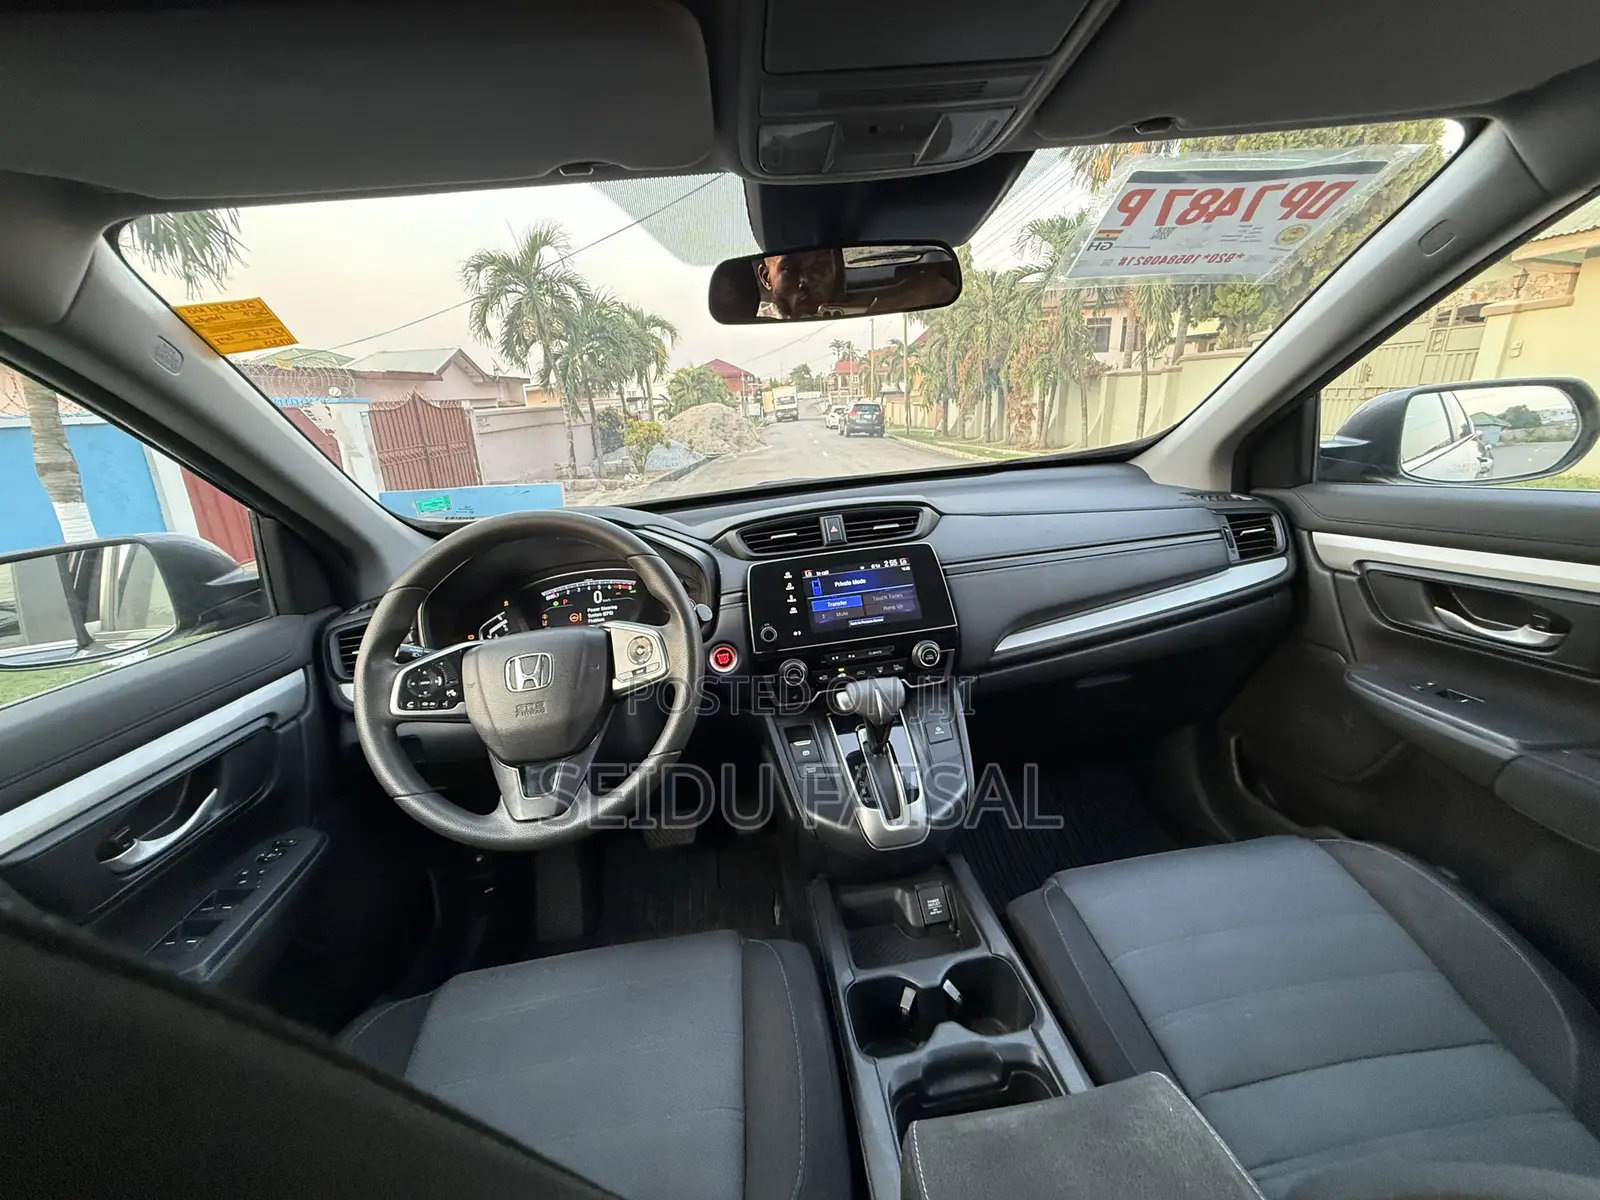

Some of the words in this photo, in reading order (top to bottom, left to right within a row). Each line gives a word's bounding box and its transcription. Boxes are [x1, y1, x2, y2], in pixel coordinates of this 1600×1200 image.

[834, 580, 852, 588] Private
[593, 590, 602, 604] 0
[827, 600, 848, 608] Transfer
